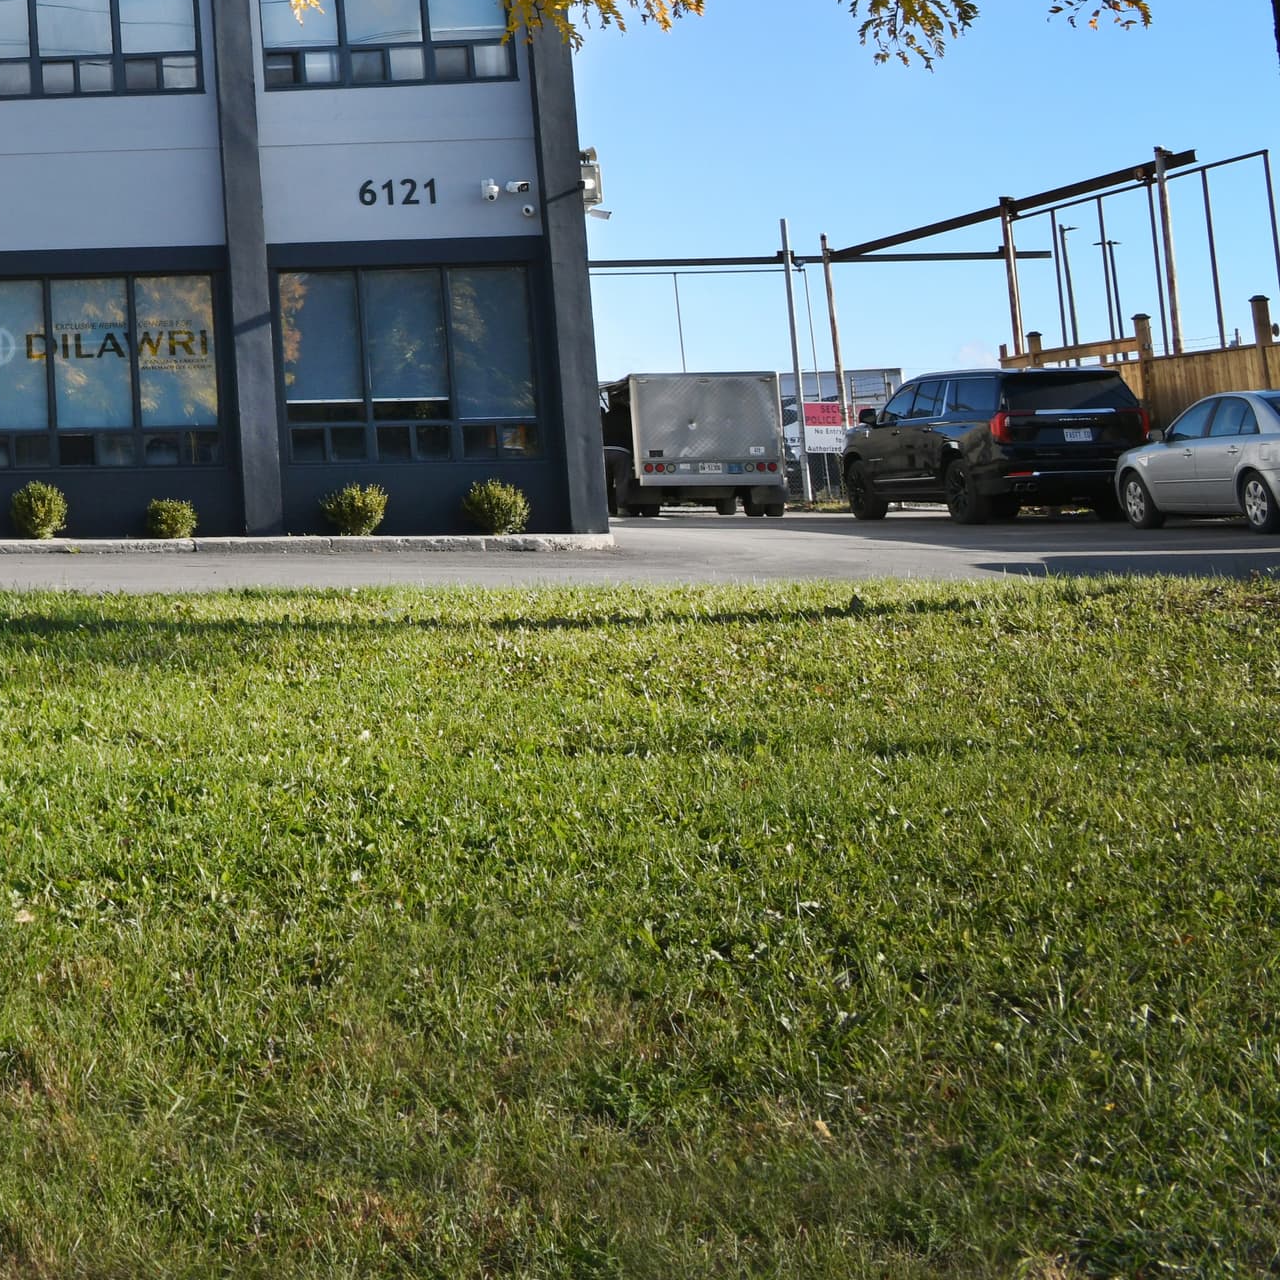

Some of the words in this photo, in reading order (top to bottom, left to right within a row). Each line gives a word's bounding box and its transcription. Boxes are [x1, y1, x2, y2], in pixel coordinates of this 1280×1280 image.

[358, 177, 437, 206] 6121
[25, 329, 209, 360] DILAWRI
[805, 415, 838, 425] POLICE
